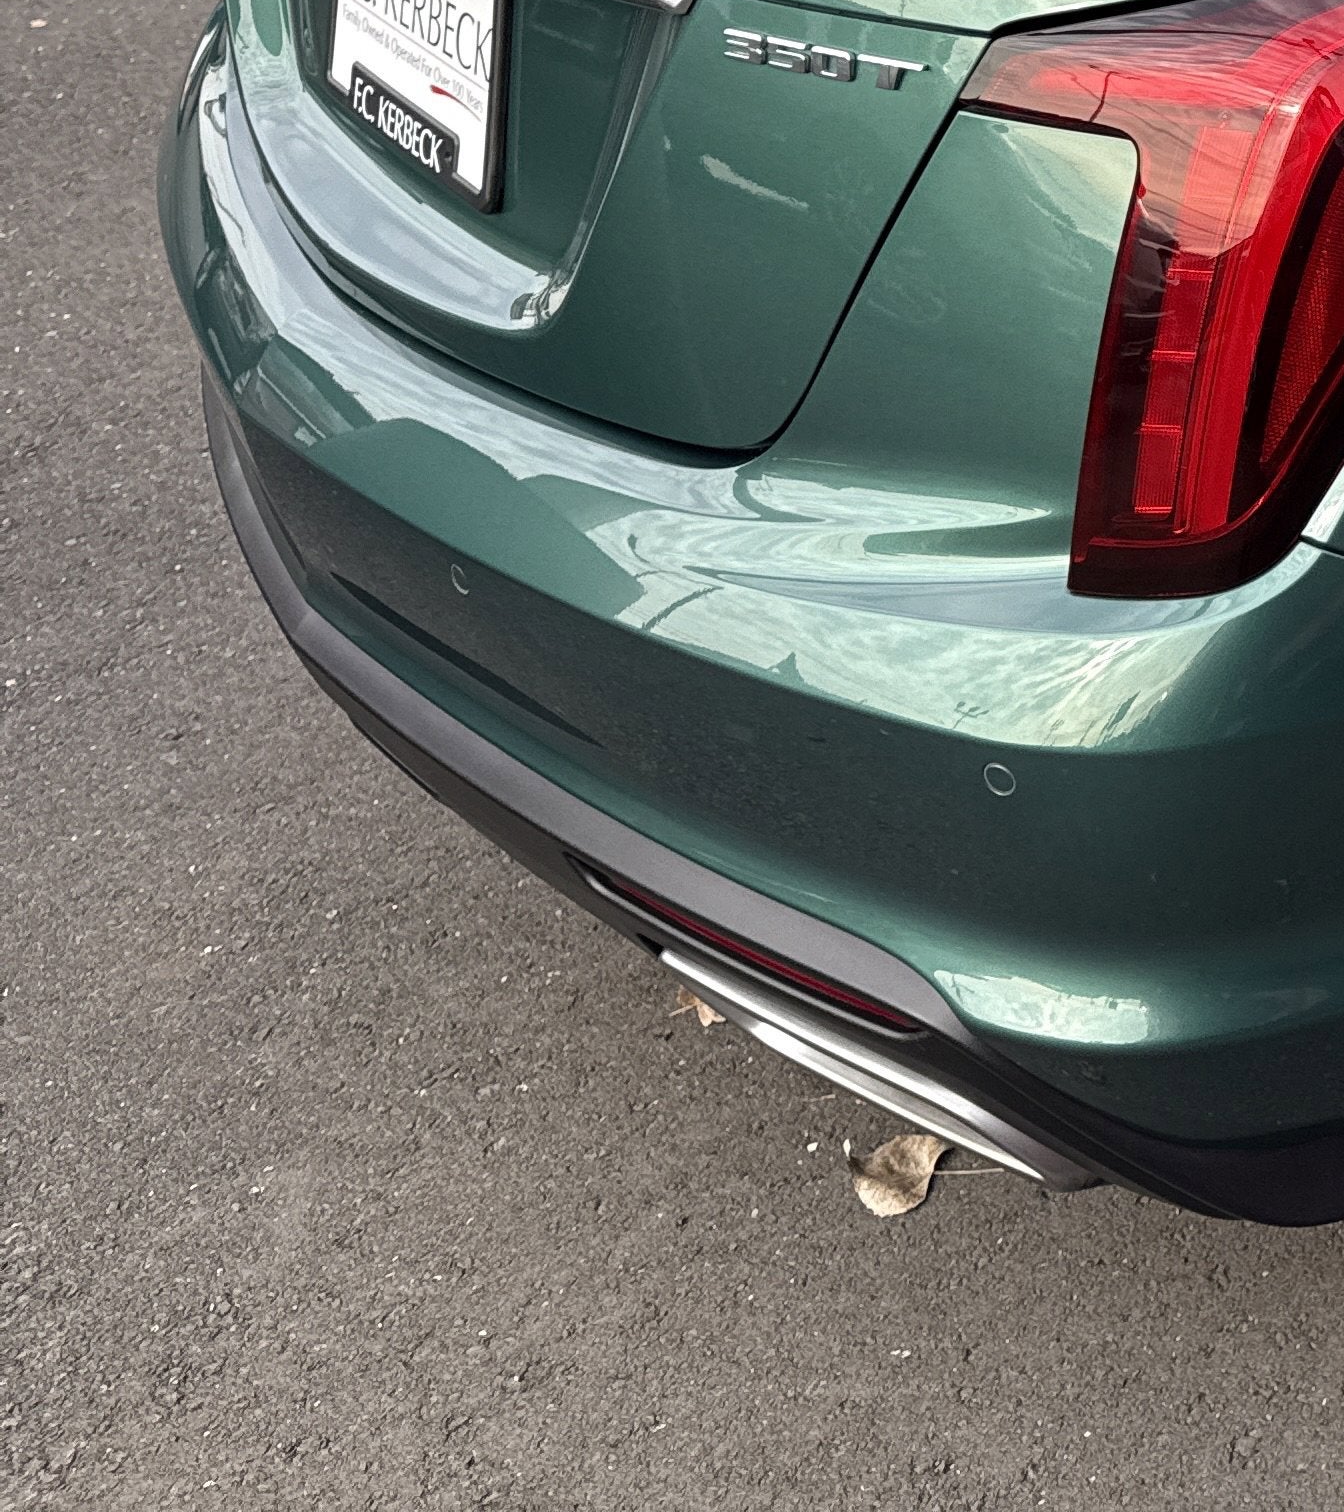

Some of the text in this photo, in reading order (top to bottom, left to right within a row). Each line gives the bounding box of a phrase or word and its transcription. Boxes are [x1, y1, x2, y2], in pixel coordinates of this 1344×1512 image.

[723, 28, 926, 91] 350T
[353, 76, 443, 174] F.C. KERBECK
